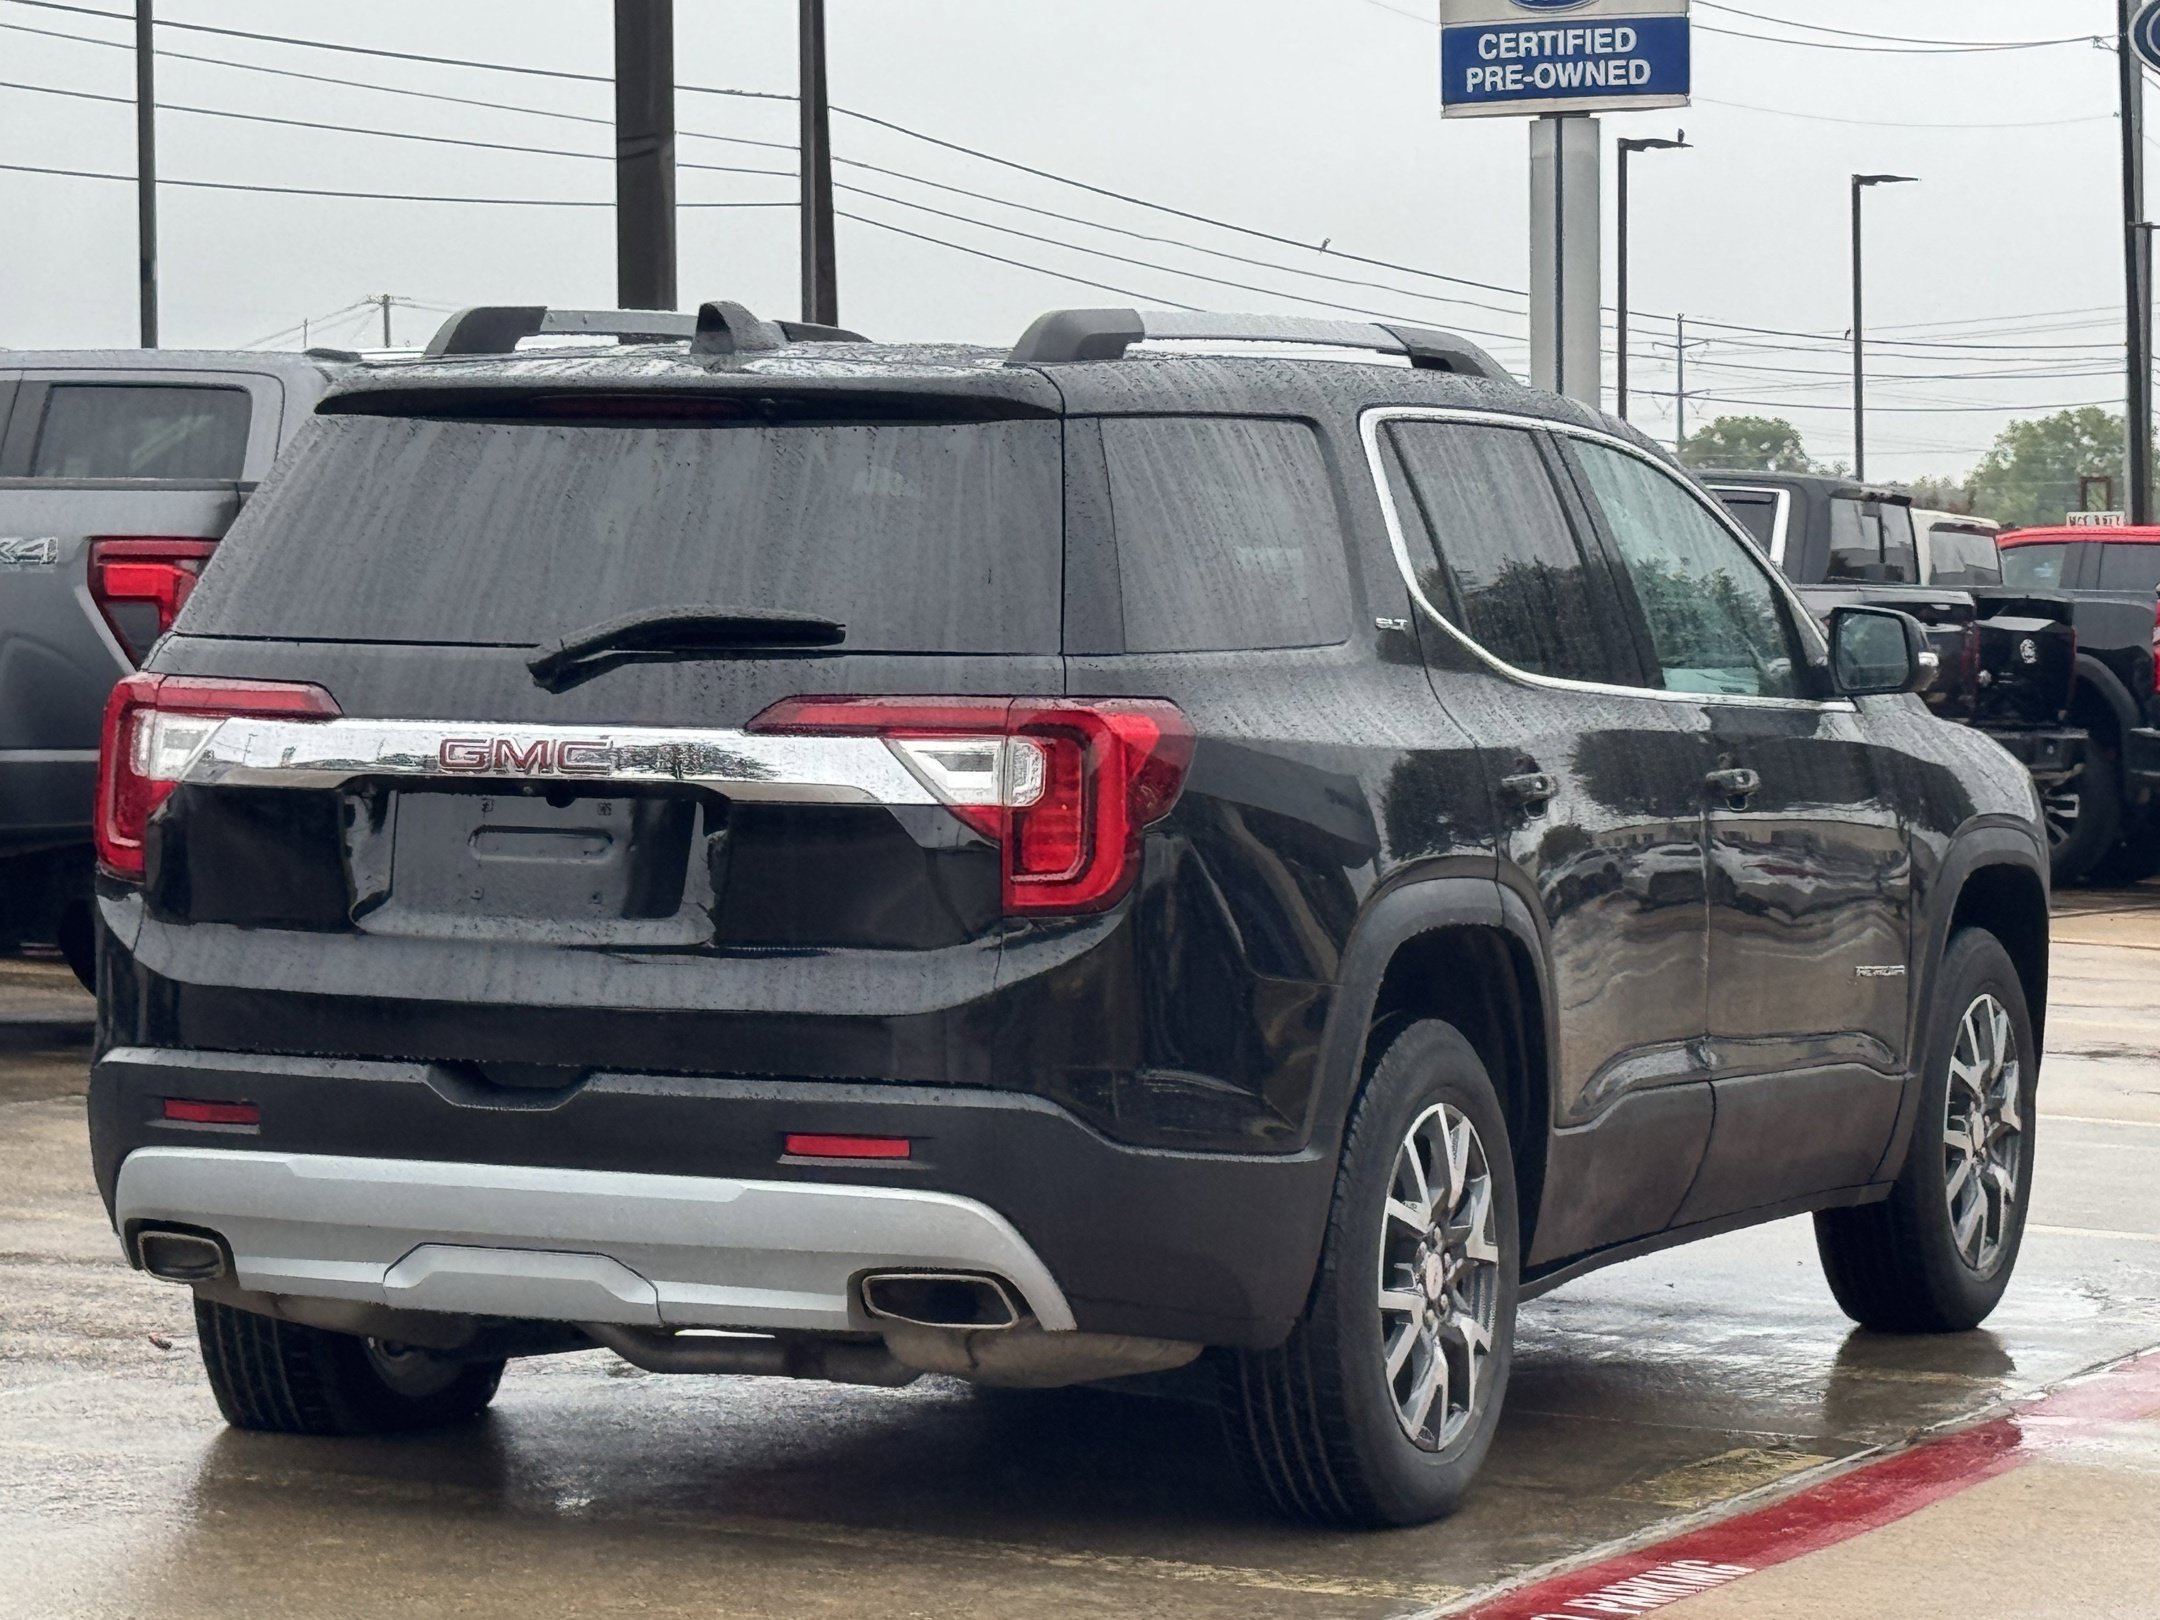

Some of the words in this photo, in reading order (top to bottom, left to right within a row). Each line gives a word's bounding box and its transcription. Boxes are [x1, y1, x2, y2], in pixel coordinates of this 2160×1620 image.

[1478, 27, 1637, 60] CERTIFIED
[1466, 59, 1651, 93] PRE-OWNED
[439, 738, 613, 775] GMC
[1562, 1560, 1755, 1615] PARKING
